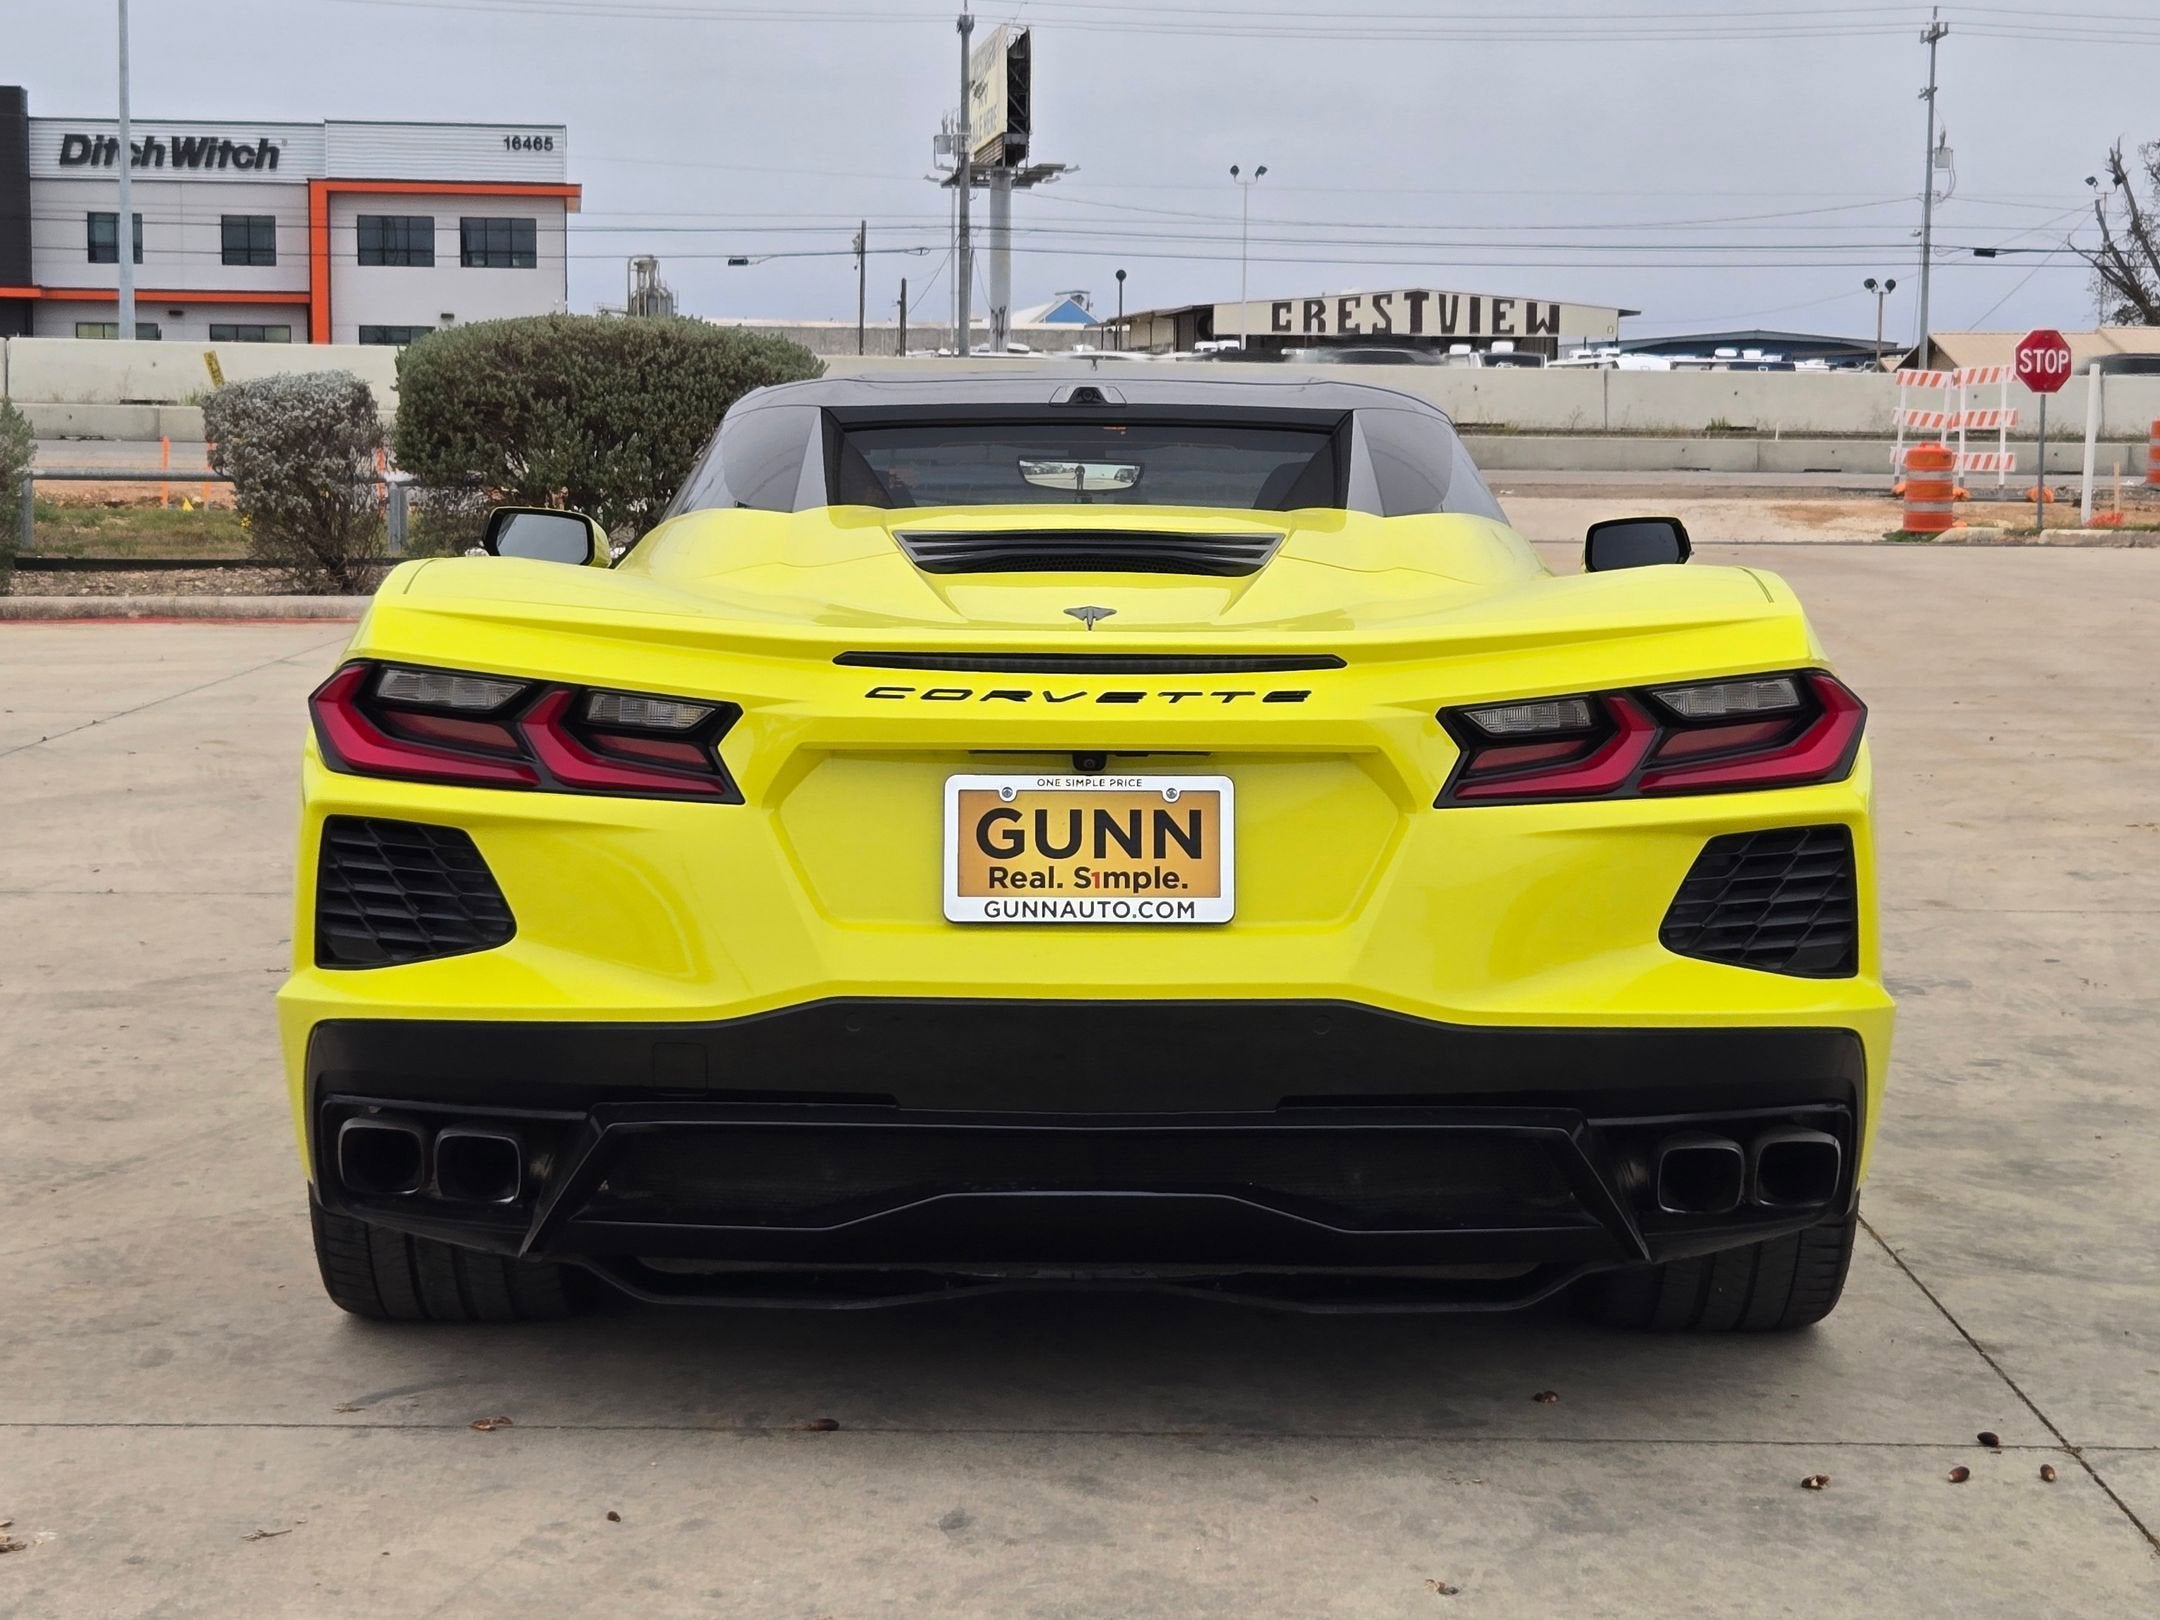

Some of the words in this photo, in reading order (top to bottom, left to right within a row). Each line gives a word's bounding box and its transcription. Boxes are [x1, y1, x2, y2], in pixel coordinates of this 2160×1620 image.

[171, 136, 281, 169] Witch
[503, 135, 554, 151] 16465
[1271, 291, 1561, 335] CRESTVIEW
[2019, 348, 2069, 373] STOP
[865, 687, 1312, 703] CORVETTE
[1037, 778, 1061, 787] ONE
[1066, 778, 1106, 787] SIMPLE
[1110, 778, 1142, 787] PRICE
[976, 807, 1202, 860] GUNN
[989, 866, 1063, 889] Real.
[1074, 866, 1188, 893] S1mple.
[984, 901, 1195, 919] GUNNAUTO.COM
